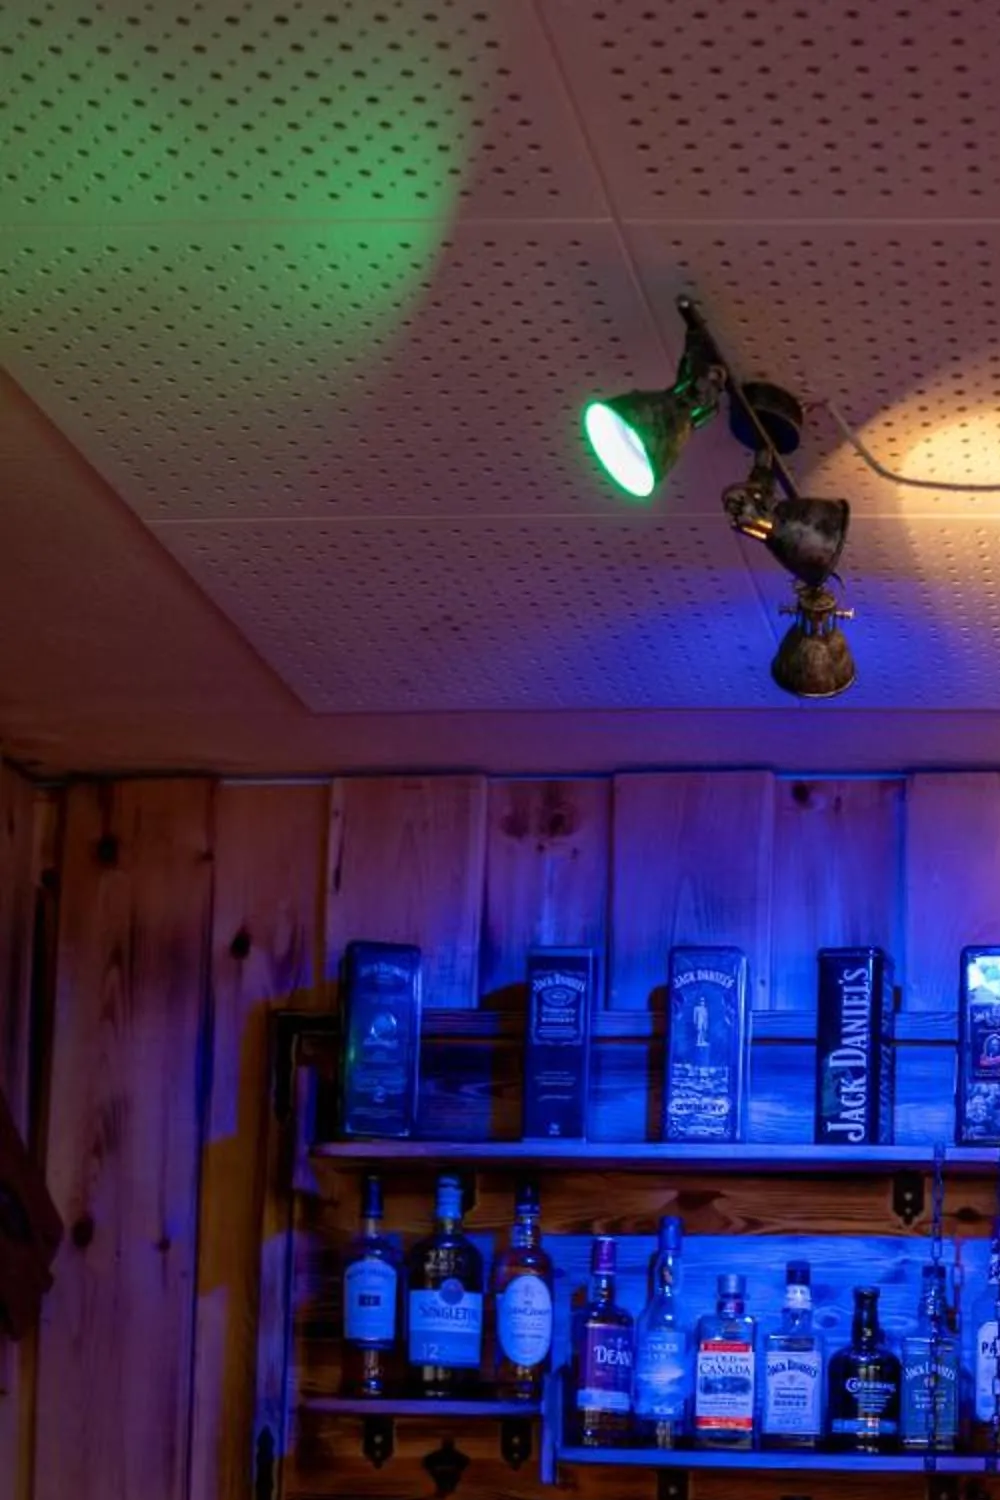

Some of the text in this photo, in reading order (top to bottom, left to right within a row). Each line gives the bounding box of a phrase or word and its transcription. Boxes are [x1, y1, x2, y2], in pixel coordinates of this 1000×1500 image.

[827, 967, 872, 1142] JACK DANIEL'S
[421, 1344, 439, 1360] 12
[700, 1363, 751, 1376] CANADA
